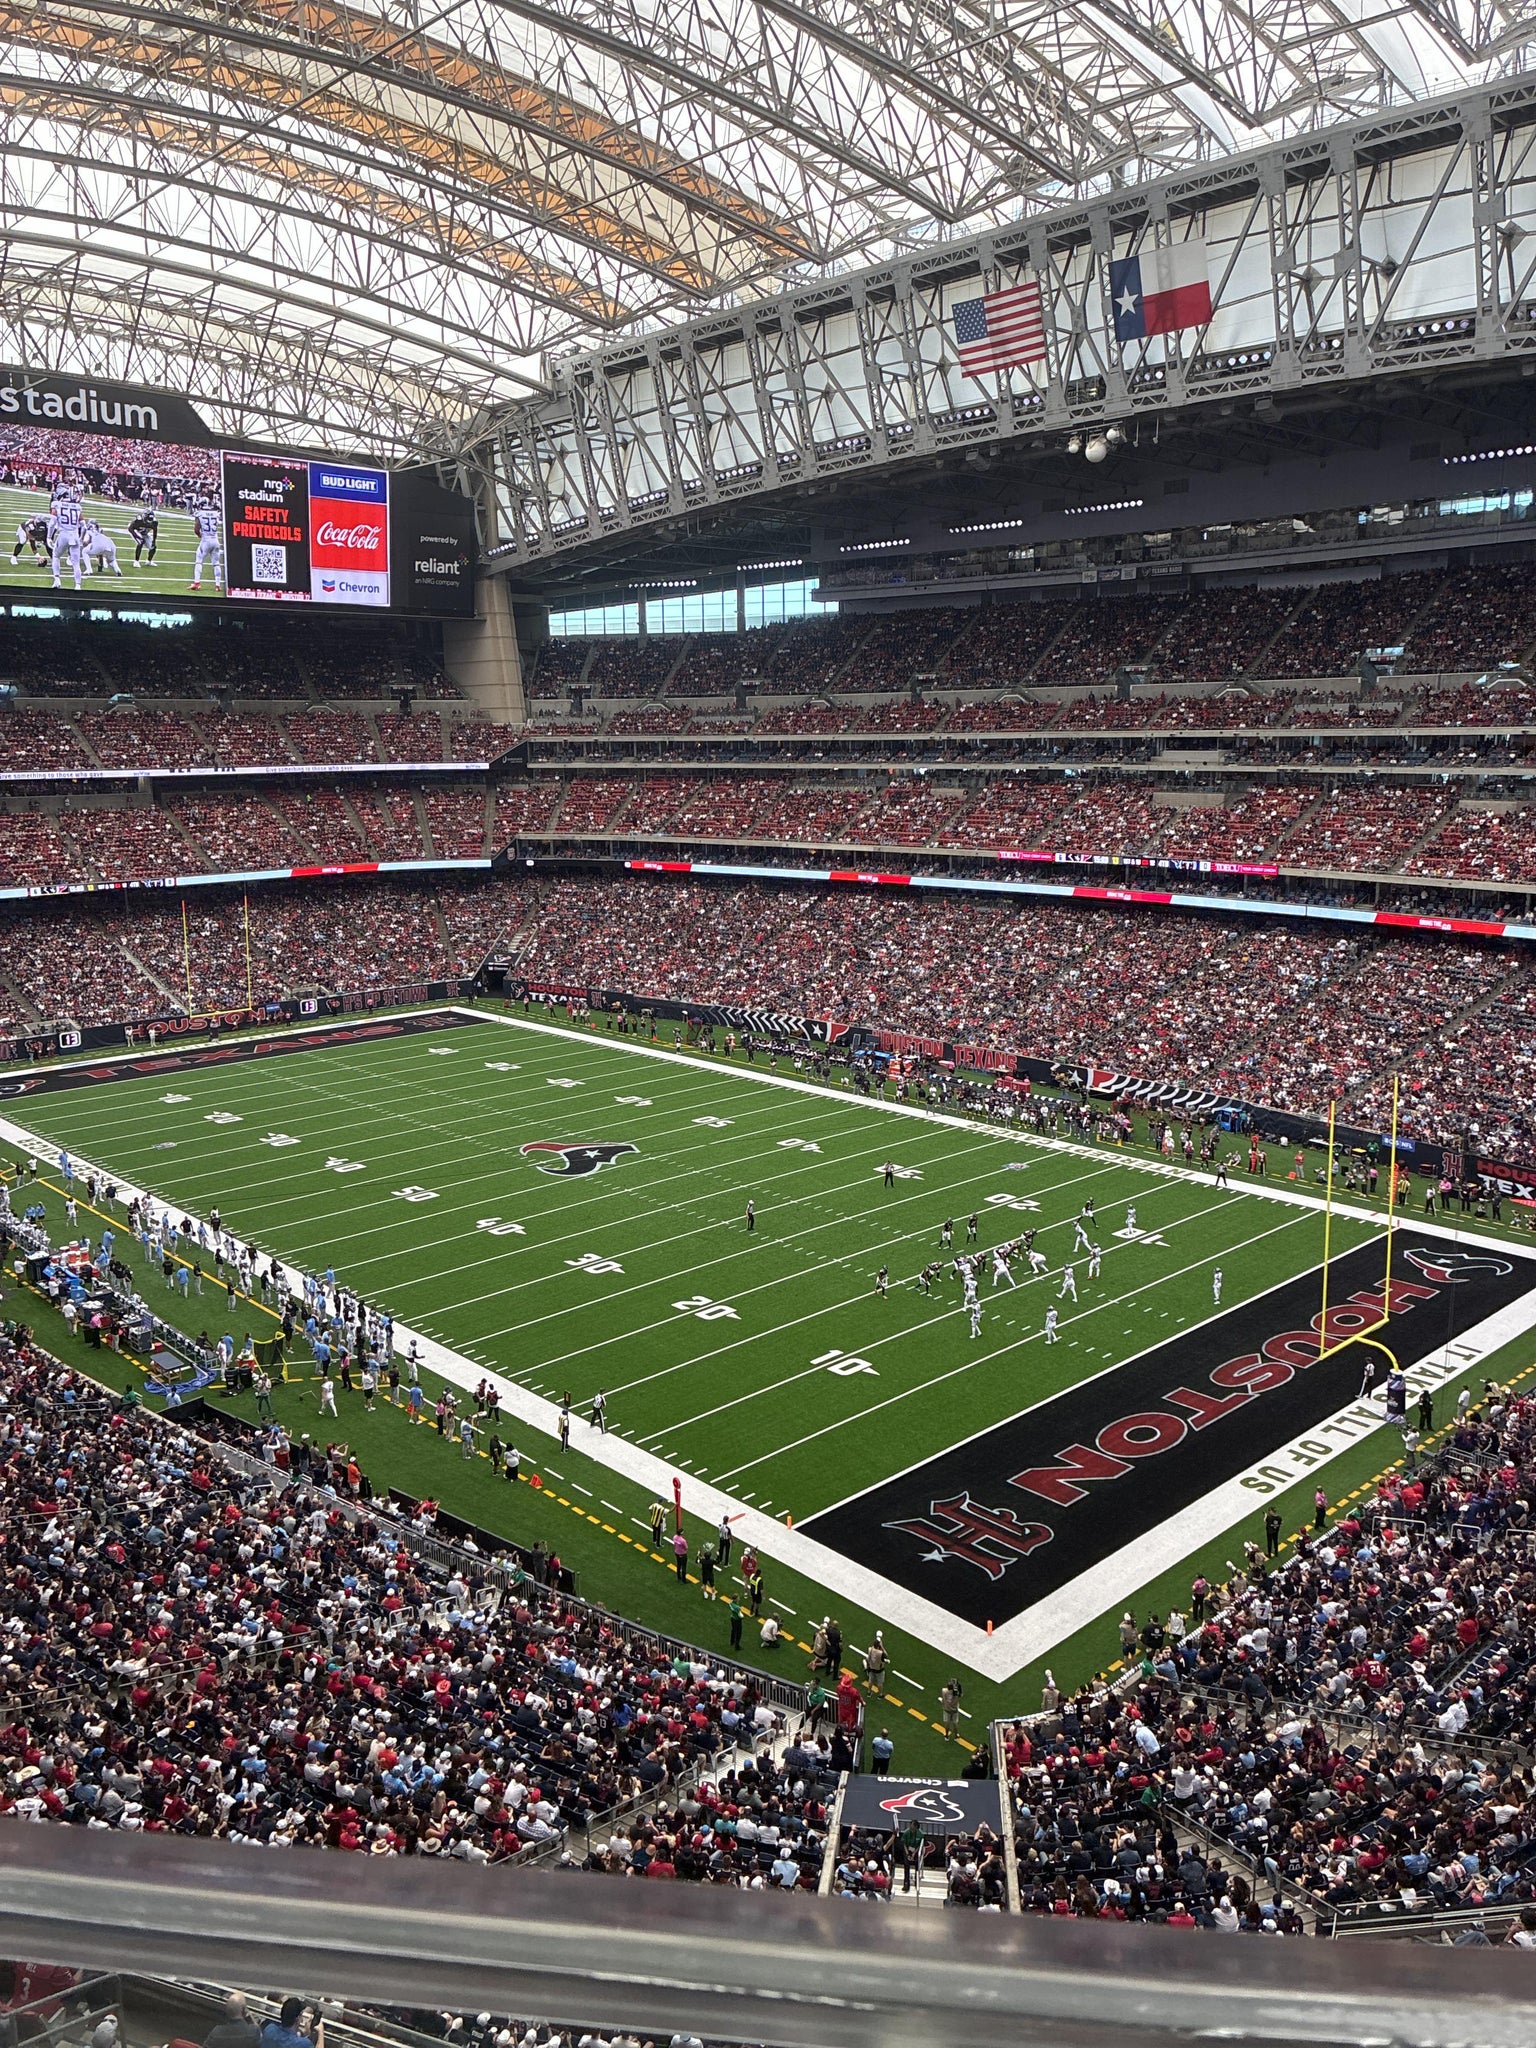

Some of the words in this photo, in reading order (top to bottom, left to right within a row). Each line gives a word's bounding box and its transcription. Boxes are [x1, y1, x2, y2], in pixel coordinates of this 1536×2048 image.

[0, 387, 158, 430] stadium
[264, 480, 283, 492] nrg
[322, 475, 346, 486] BUD
[346, 479, 377, 491] LIGHT
[238, 489, 283, 503] stadium
[60, 508, 77, 525] 50
[244, 505, 289, 523] SAFETY
[203, 517, 217, 532] 33
[233, 522, 302, 541] PROTOCOLS
[420, 535, 449, 544] powered
[450, 537, 458, 546] by
[414, 558, 460, 575] reliant
[339, 581, 380, 594] Chevron
[435, 580, 460, 588] company
[528, 983, 588, 997] HOUSTON
[125, 1007, 265, 1039] HOUSTON
[953, 1044, 1017, 1070] TEXANS
[1401, 1140, 1413, 1150] NFL
[390, 1185, 441, 1202] 50
[475, 1217, 523, 1236] 40
[564, 1253, 616, 1274] 30
[671, 1295, 733, 1321] 20
[1444, 1343, 1484, 1361] IT
[810, 1350, 870, 1377] 10
[1006, 1277, 1440, 1508] HOUSTON
[1319, 1405, 1386, 1437] ALL
[1286, 1439, 1334, 1468] OF
[1239, 1464, 1296, 1494] US
[1319, 1580, 1332, 1590] 24
[1370, 1664, 1380, 1675] 24
[556, 1697, 568, 1710] 53
[877, 1775, 943, 1787] Chevron
[1262, 1843, 1269, 1854] 7
